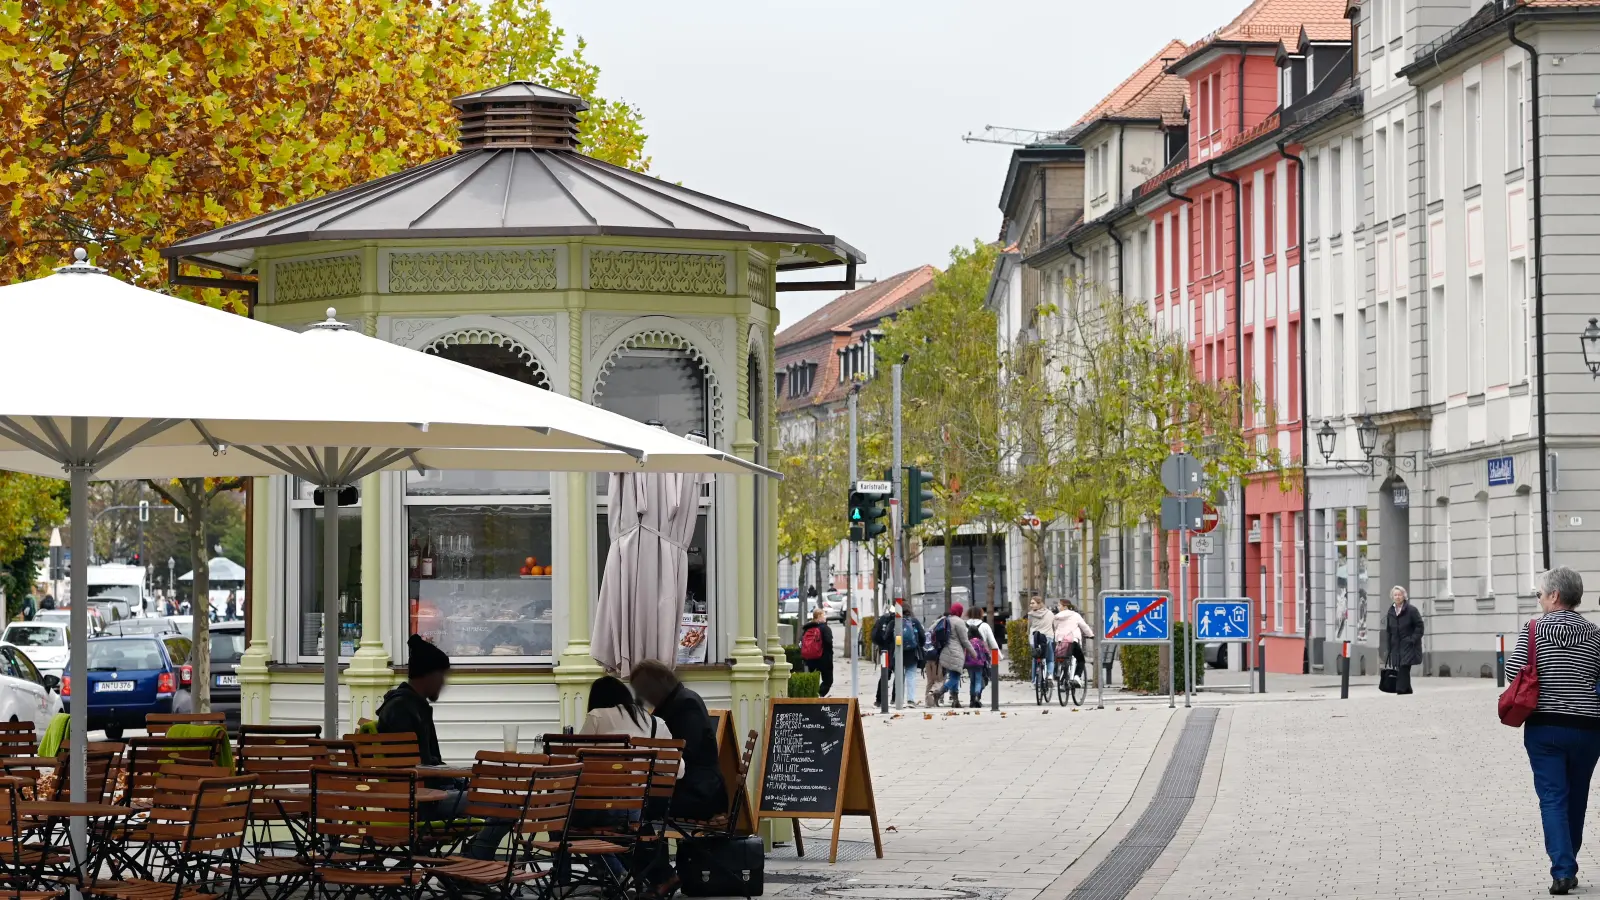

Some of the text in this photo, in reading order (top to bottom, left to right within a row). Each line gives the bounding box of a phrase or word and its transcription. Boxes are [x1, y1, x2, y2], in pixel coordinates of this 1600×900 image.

[775, 720, 802, 729] ESPRESSO
[774, 754, 790, 762] LATTE
[772, 763, 784, 772] CHAI
[785, 763, 799, 772] LATTE
